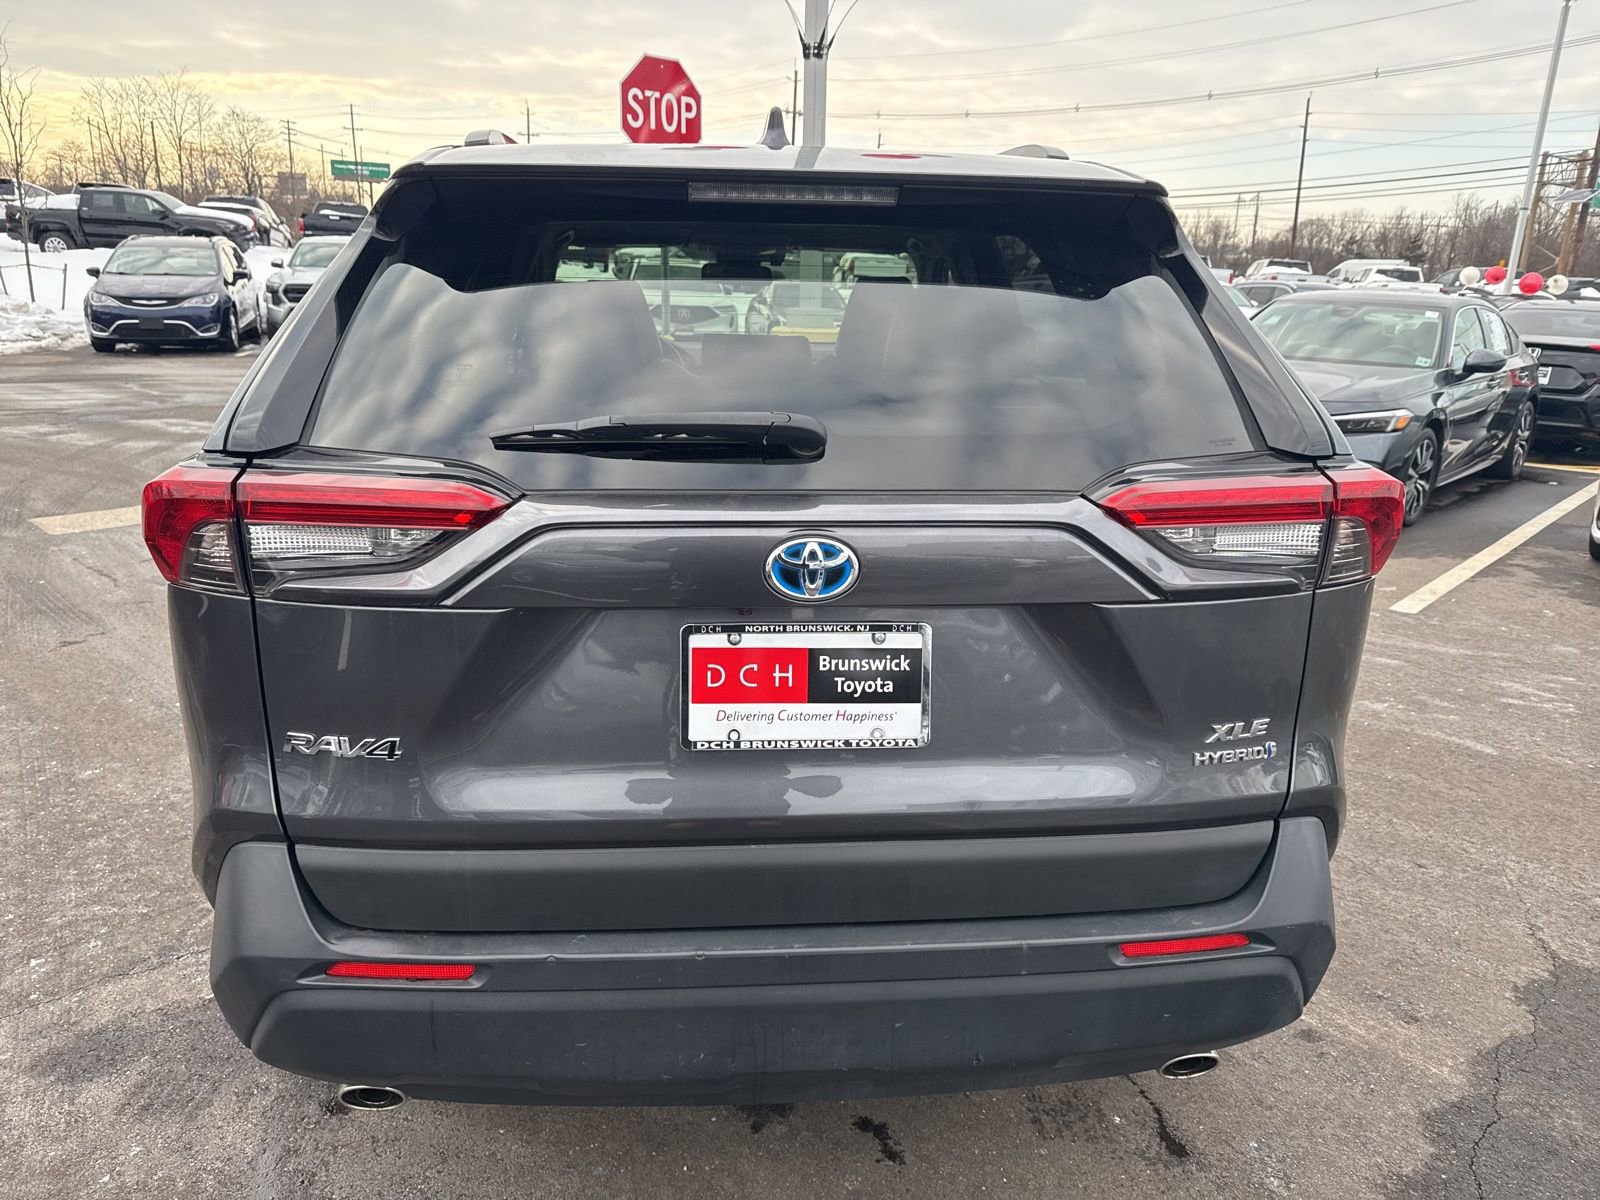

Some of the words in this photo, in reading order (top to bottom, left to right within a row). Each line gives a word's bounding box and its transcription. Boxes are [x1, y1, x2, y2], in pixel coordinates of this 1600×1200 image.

[626, 87, 697, 134] STOP
[856, 624, 870, 632] NJ
[818, 655, 911, 672] Brunswick
[834, 676, 894, 697] Toyota
[716, 709, 775, 724] Delivering
[777, 709, 834, 722] Customer
[1204, 717, 1271, 743] XLE
[283, 731, 402, 761] RAV4
[696, 740, 735, 749] DCH
[740, 740, 845, 748] BRUNSWICK
[848, 739, 916, 748] TOYOTA
[1193, 745, 1267, 767] HYBRID
